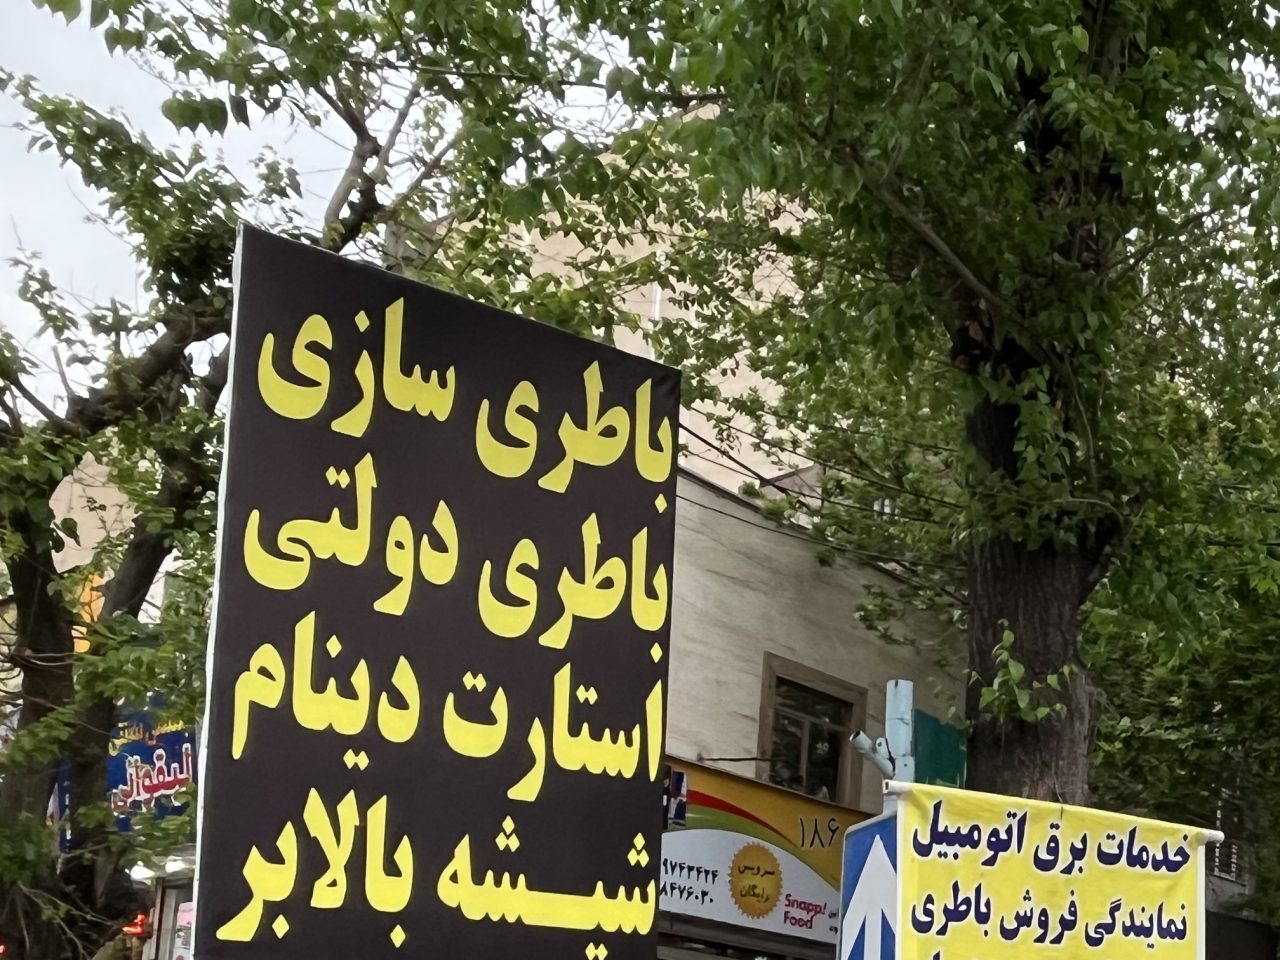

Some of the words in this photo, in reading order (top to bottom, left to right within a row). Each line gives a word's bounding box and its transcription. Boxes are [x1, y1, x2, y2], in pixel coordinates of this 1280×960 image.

[257, 297, 456, 437] سازی
[476, 360, 673, 512] باطری
[243, 453, 459, 615] دولتی
[478, 512, 669, 664] باطری
[232, 611, 420, 770] دینام
[442, 663, 662, 801] استارت
[800, 817, 840, 848] ۱۸۶
[912, 799, 1027, 867] اتومبیل
[1032, 822, 1088, 875] برق
[1096, 826, 1191, 873] خدمات
[216, 787, 414, 946] بالابر
[783, 910, 815, 930] Food
[784, 893, 828, 915] Snapp!
[911, 881, 991, 939] باطری
[999, 892, 1078, 945] فروش
[1084, 899, 1187, 948] نمایندگی
